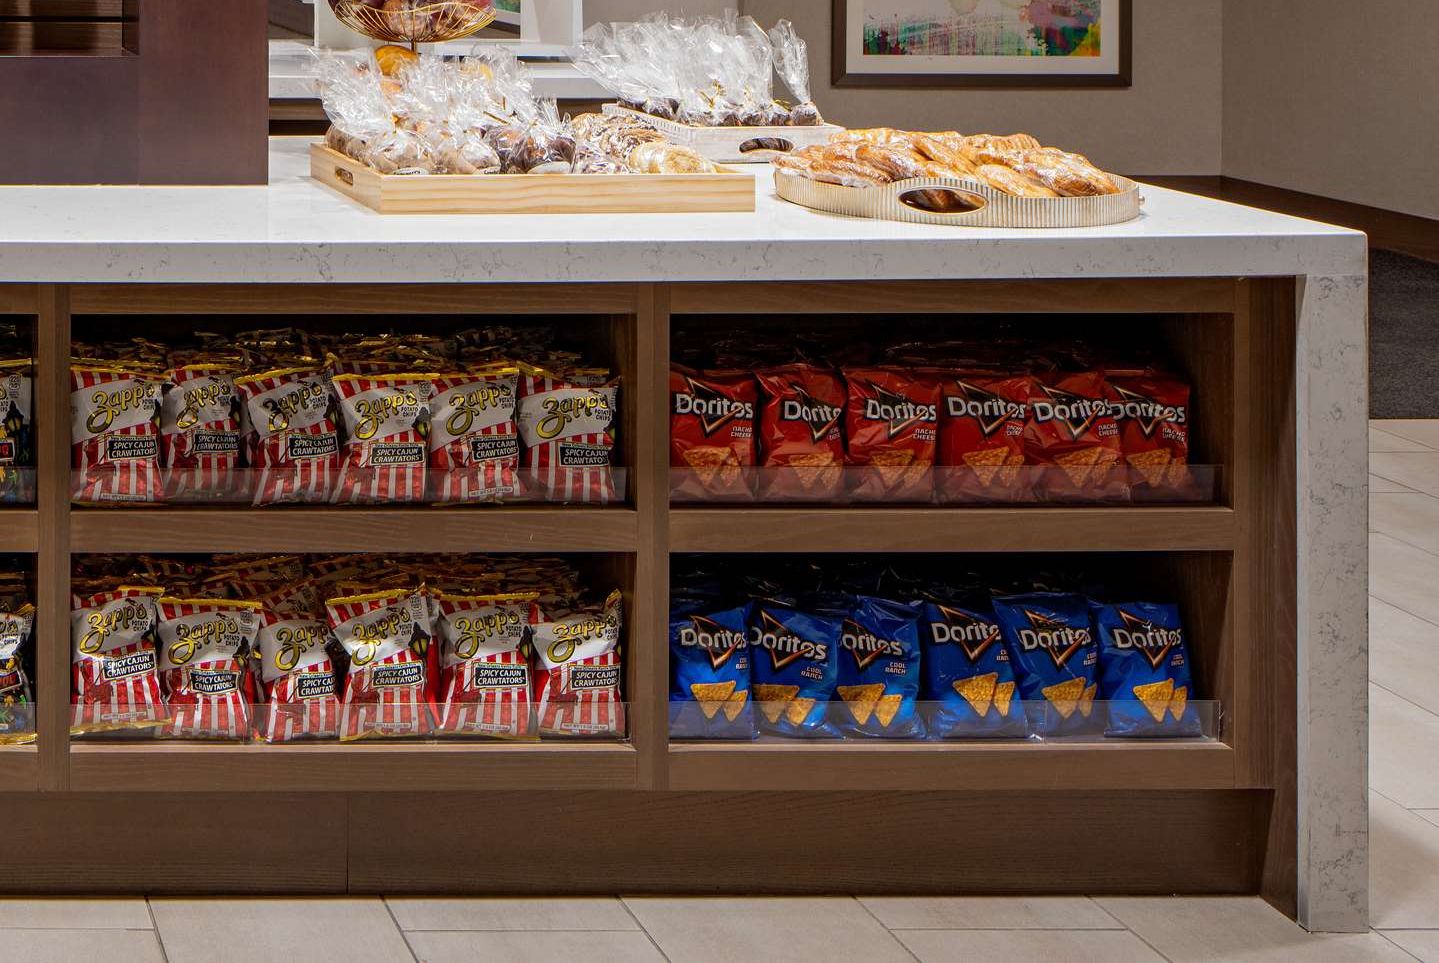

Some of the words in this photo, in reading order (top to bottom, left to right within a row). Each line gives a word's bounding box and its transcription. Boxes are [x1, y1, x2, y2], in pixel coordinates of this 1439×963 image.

[87, 382, 154, 434] Zapp's
[263, 382, 322, 432] Zapp's
[446, 386, 511, 436] Zapp's
[676, 393, 753, 419] Doritos
[784, 401, 842, 422] Dorito
[867, 399, 936, 421] Doritos
[947, 397, 1025, 418] Doritos
[1032, 399, 1113, 422] Doritos
[354, 391, 417, 440] Zapp's
[536, 393, 609, 438] Zapp's
[113, 441, 132, 450] SPICY
[134, 441, 155, 449] CAJUN
[294, 439, 312, 448] SPICY
[313, 439, 334, 447] CAJUN
[477, 442, 496, 450] SPICY
[497, 440, 517, 449] CAJUN
[111, 448, 156, 458] CRAWTATORS
[292, 446, 335, 456] CRAWTATORS
[376, 448, 394, 456] SPICY
[476, 448, 517, 459] CRAWTATORS
[374, 455, 420, 463] CRAWTATORS
[80, 602, 147, 653] Zapp's
[931, 622, 1001, 643] Dorito
[168, 619, 239, 664] Zapp's
[351, 611, 410, 665] Zapp's
[455, 611, 519, 659] Zapp's
[546, 618, 617, 663] Zapp's
[681, 628, 748, 649] Doritos
[1020, 627, 1092, 650] Doritos
[1113, 628, 1182, 649] Doritos
[841, 634, 903, 656] oritos
[107, 659, 127, 669] SPICY
[128, 655, 150, 666] CAJUN
[106, 663, 152, 678] CRAWTATORS
[377, 669, 396, 677] SPICY
[398, 667, 418, 676] CAJUN
[479, 669, 499, 678] SPICY
[501, 669, 522, 677] CAJUN
[576, 671, 595, 679] SPICY
[596, 671, 617, 679] CAJUN
[800, 671, 824, 680] RANCH
[806, 666, 823, 675] COOL
[885, 667, 906, 675] RANCH
[195, 676, 212, 684] SPICY
[213, 674, 232, 683] CAJUN
[302, 679, 320, 687] SPICY
[375, 675, 420, 685] CRAWTATORS
[477, 677, 523, 685] CRAWTATORS
[574, 678, 618, 687] CRAWTATORS
[194, 682, 233, 692] CRAWTATORS
